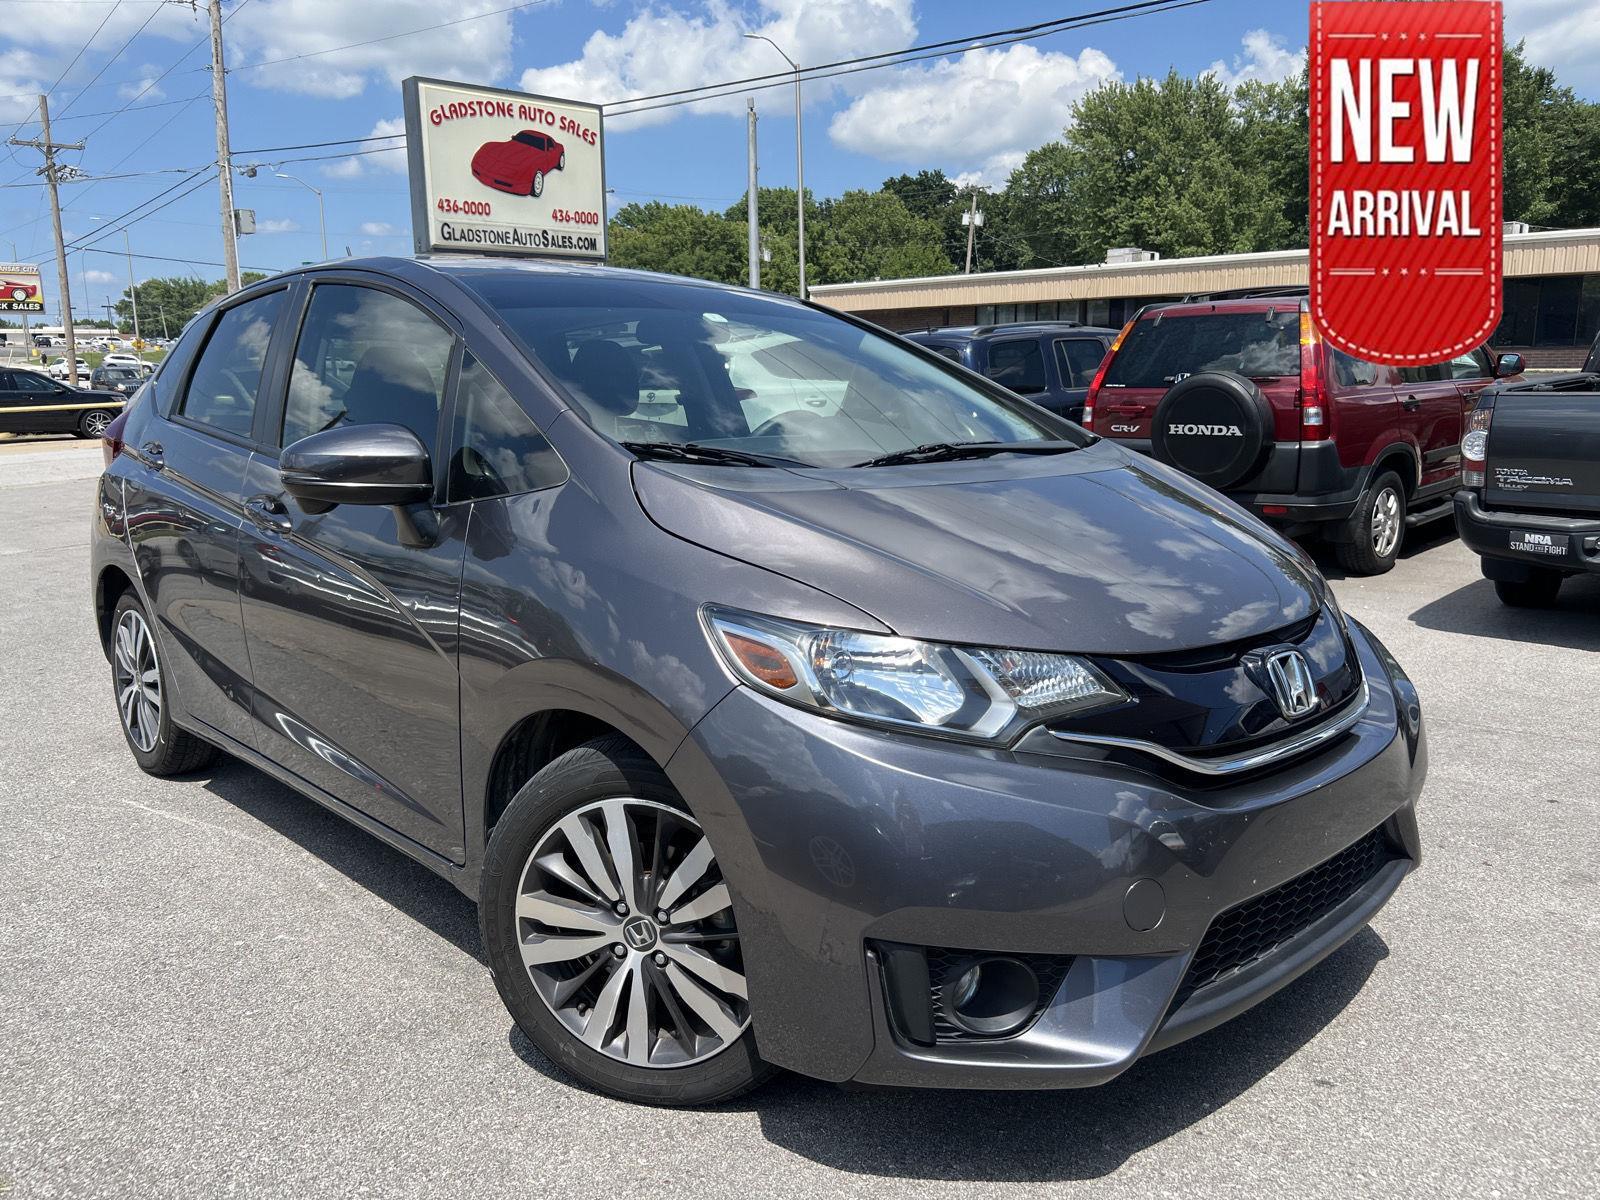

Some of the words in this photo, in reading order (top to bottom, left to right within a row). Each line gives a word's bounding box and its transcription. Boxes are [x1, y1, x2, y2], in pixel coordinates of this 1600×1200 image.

[430, 100, 514, 127] GLADSTONE
[518, 104, 556, 126] AUTO
[559, 115, 598, 146] SALES
[437, 198, 492, 217] 436-0000
[551, 208, 599, 225] 436-0000
[1110, 424, 1141, 433] CR-V
[1168, 423, 1244, 437] HONDA
[1495, 467, 1529, 476] TOYOTA
[1494, 475, 1574, 486] TACOMA
[1524, 533, 1552, 546] NRA
[1510, 541, 1535, 552] STAND
[1544, 545, 1567, 556] FIGHT
